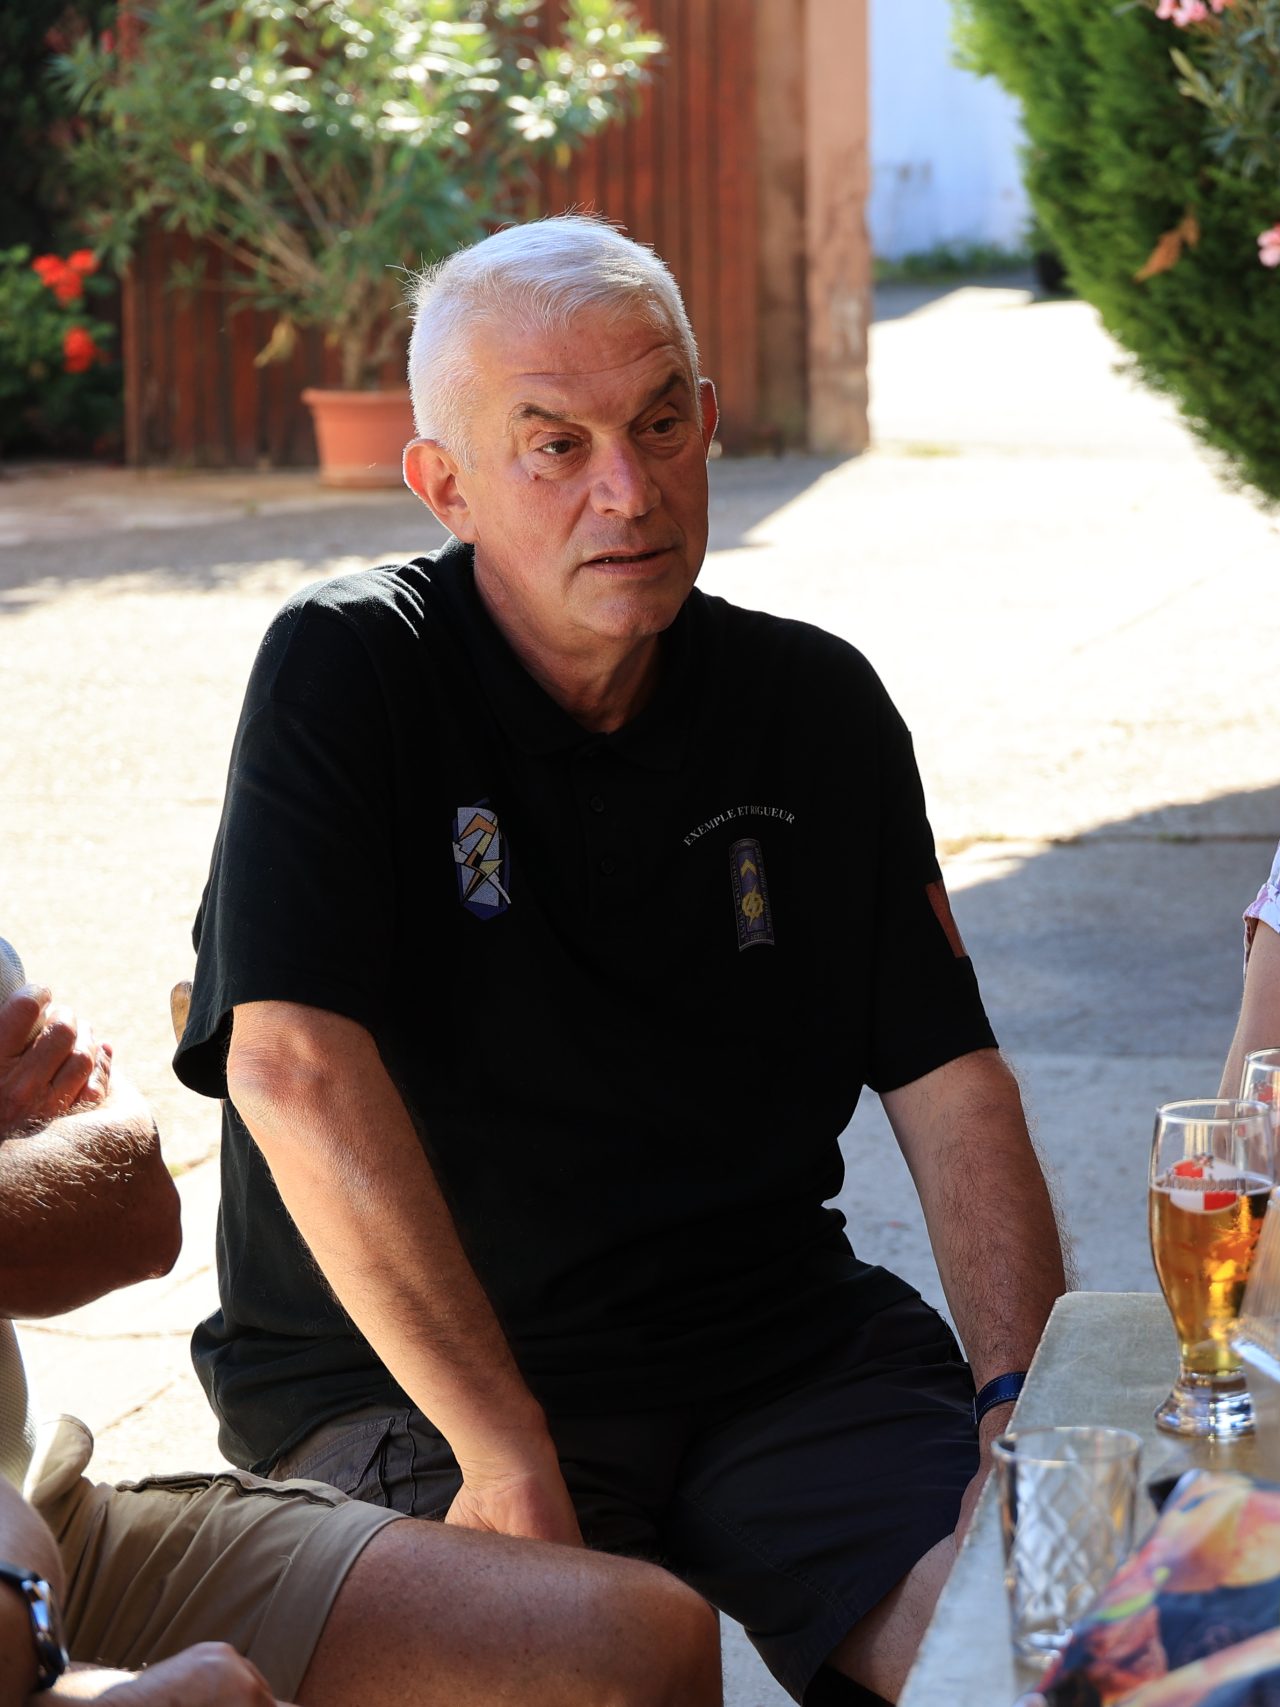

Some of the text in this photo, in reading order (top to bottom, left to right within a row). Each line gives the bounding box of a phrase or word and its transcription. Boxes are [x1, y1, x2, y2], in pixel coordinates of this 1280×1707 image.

[682, 805, 796, 847] EXEMPLE ET RIGUEUR
